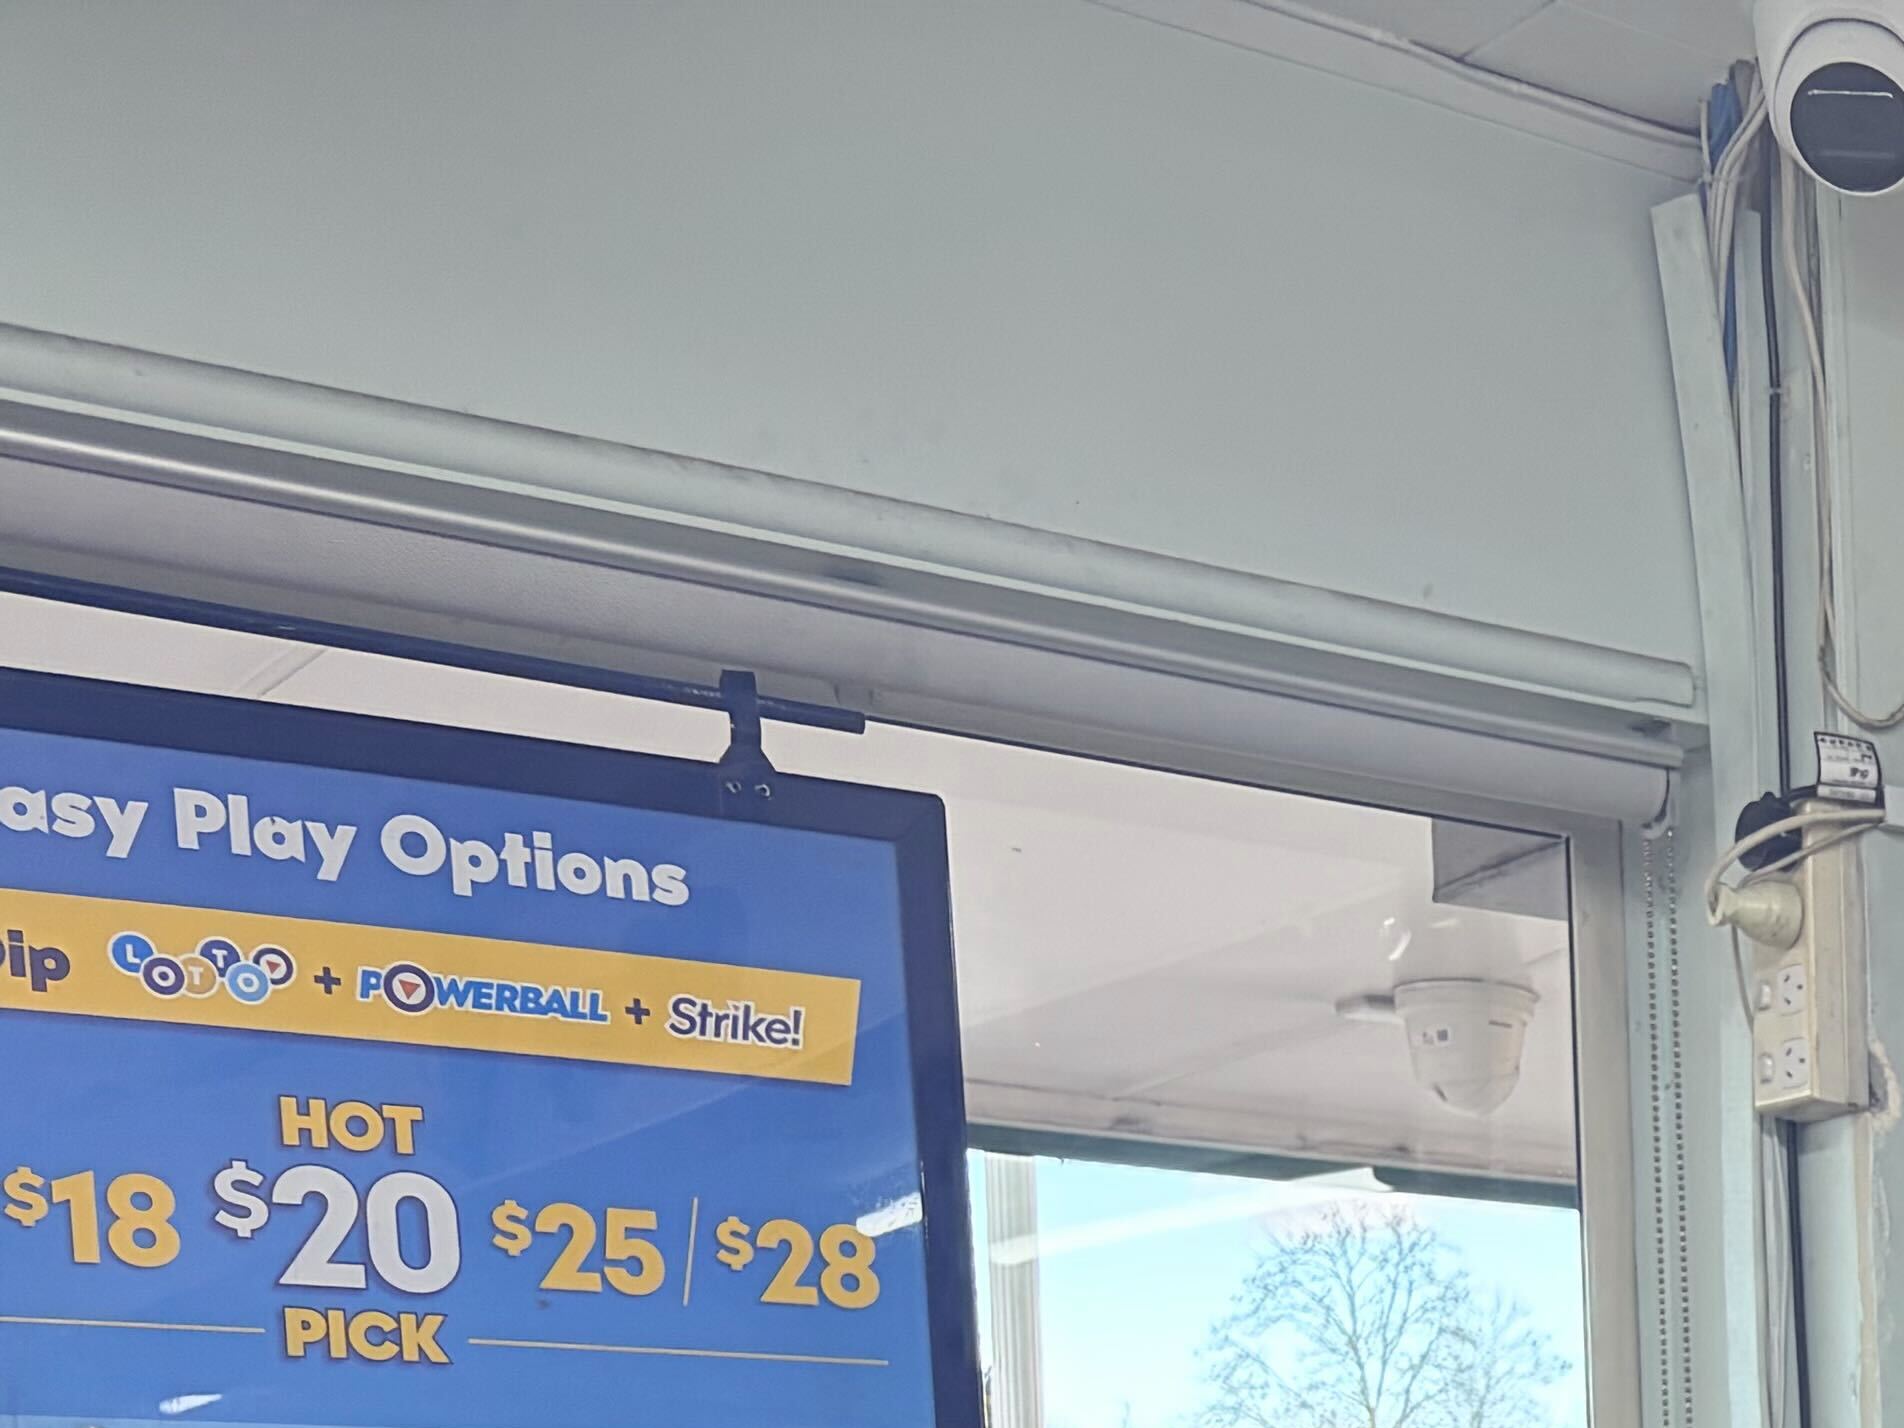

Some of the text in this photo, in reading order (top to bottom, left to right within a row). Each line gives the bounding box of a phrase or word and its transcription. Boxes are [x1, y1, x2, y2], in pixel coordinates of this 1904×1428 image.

[175, 789, 357, 881] Play
[381, 815, 691, 907] Options
[0, 931, 72, 991] ip
[358, 963, 609, 1025] POWERBALL
[664, 997, 806, 1050] Strike!
[279, 1095, 424, 1155] HOT
[2, 1160, 881, 1309] $18 $20 $25 $28
[283, 1310, 454, 1365] PICK
